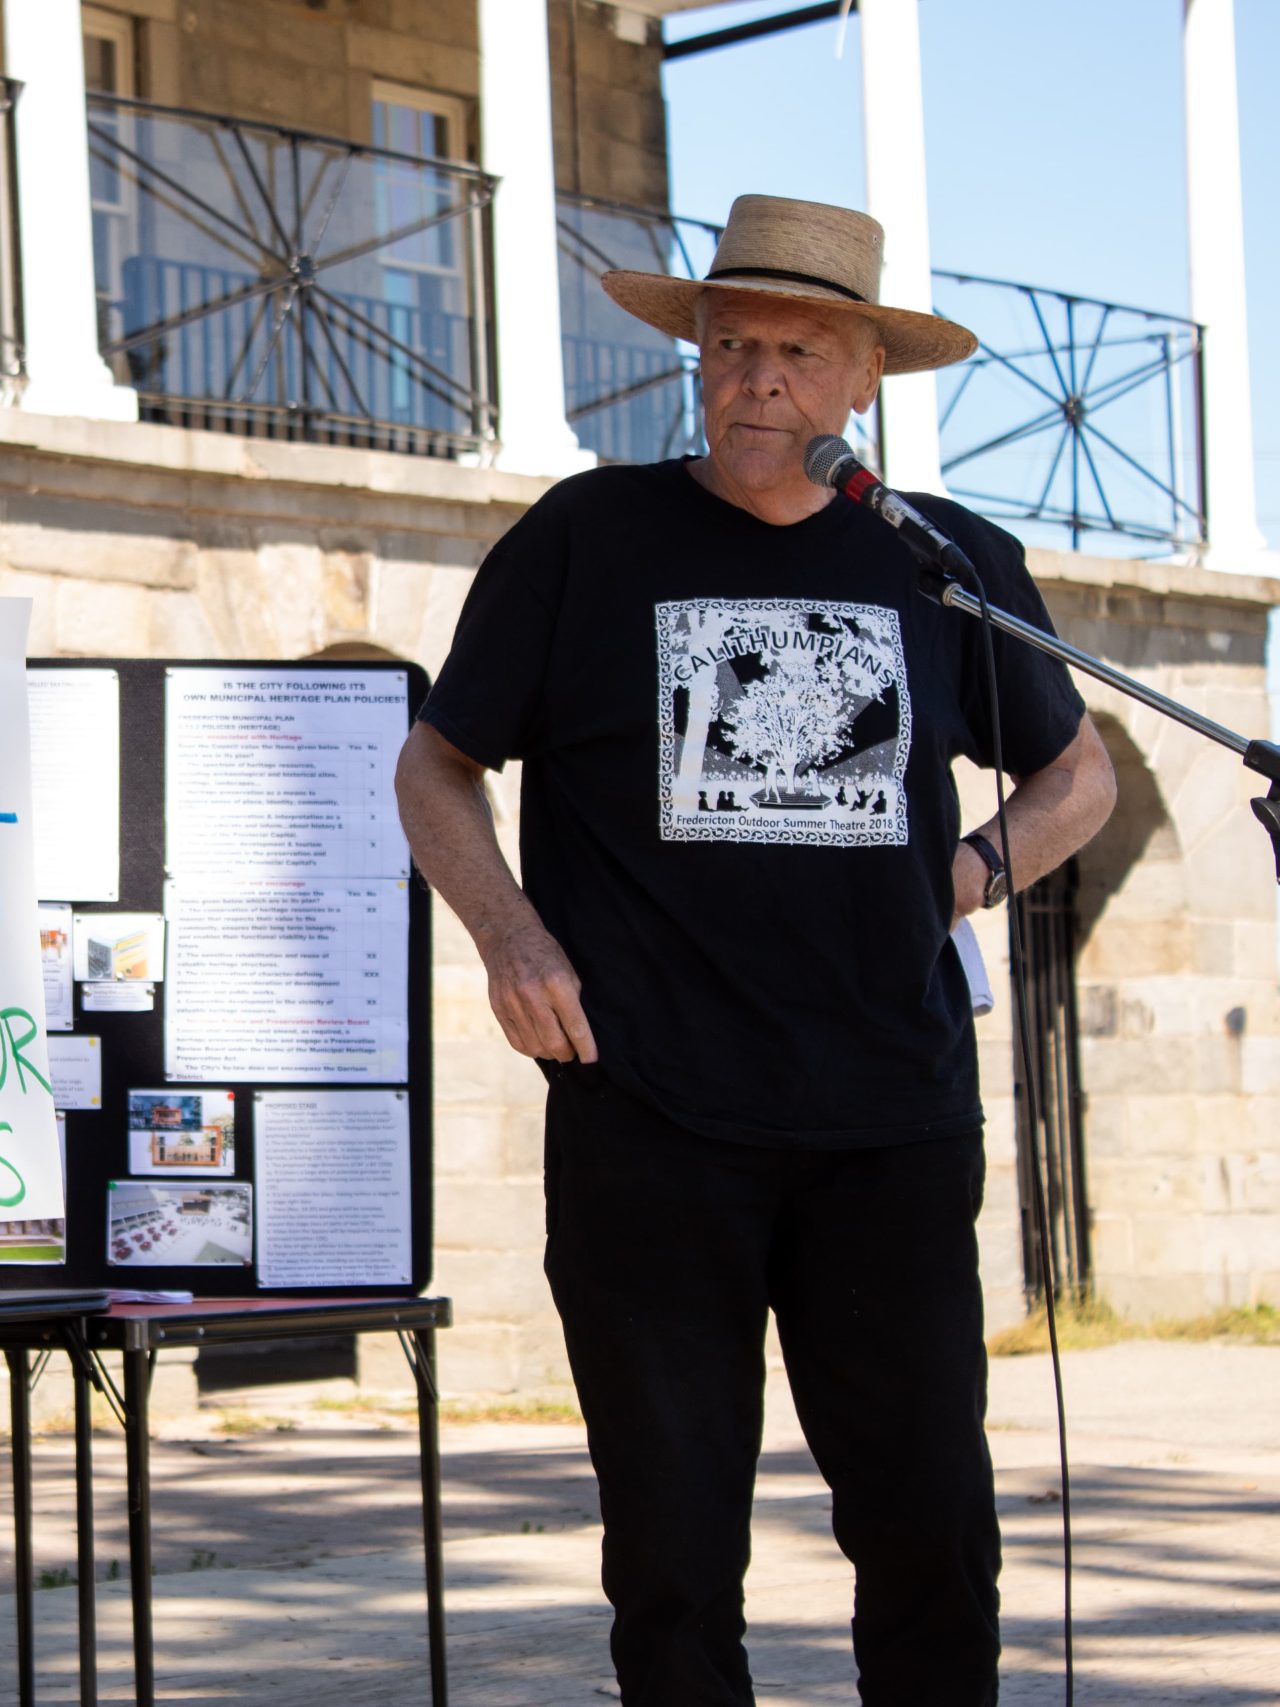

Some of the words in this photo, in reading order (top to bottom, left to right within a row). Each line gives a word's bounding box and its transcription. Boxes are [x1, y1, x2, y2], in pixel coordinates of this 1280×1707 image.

[674, 630, 896, 689] CALITHUMPIANS
[236, 682, 257, 690] THE
[286, 683, 347, 691] FOLLOWING
[349, 683, 366, 691] ITS
[210, 695, 266, 703] MUNICIPAL
[269, 695, 322, 704] HERITAGE
[324, 696, 351, 704] PLAN
[676, 814, 735, 826] Fredericton
[738, 816, 781, 828] Outdoor
[783, 817, 827, 829] Summer
[830, 818, 866, 830] Theatre
[869, 818, 894, 829] 2018
